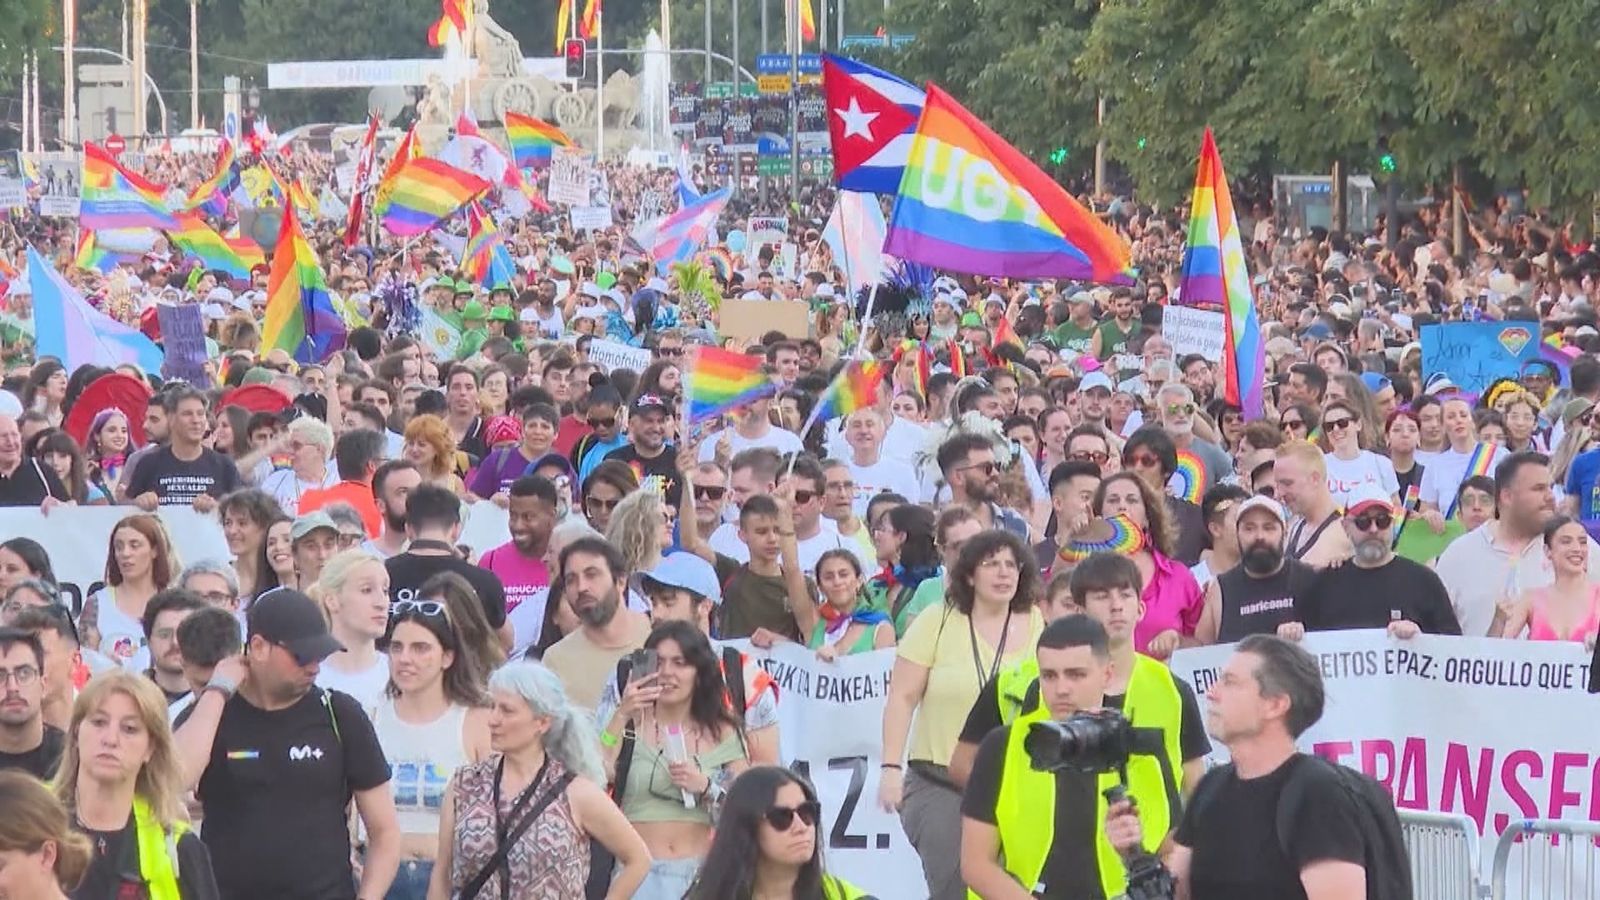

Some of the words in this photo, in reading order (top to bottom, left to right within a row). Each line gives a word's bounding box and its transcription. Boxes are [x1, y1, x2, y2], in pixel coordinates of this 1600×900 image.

[159, 476, 215, 485] DIVERSIDADES
[1319, 651, 1378, 679] EITOS
[1385, 649, 1394, 674] E
[1397, 648, 1438, 680] PAZ:
[1444, 657, 1533, 688] ORGULLO
[1538, 663, 1574, 690] QUE
[815, 673, 879, 702] BAKEA:
